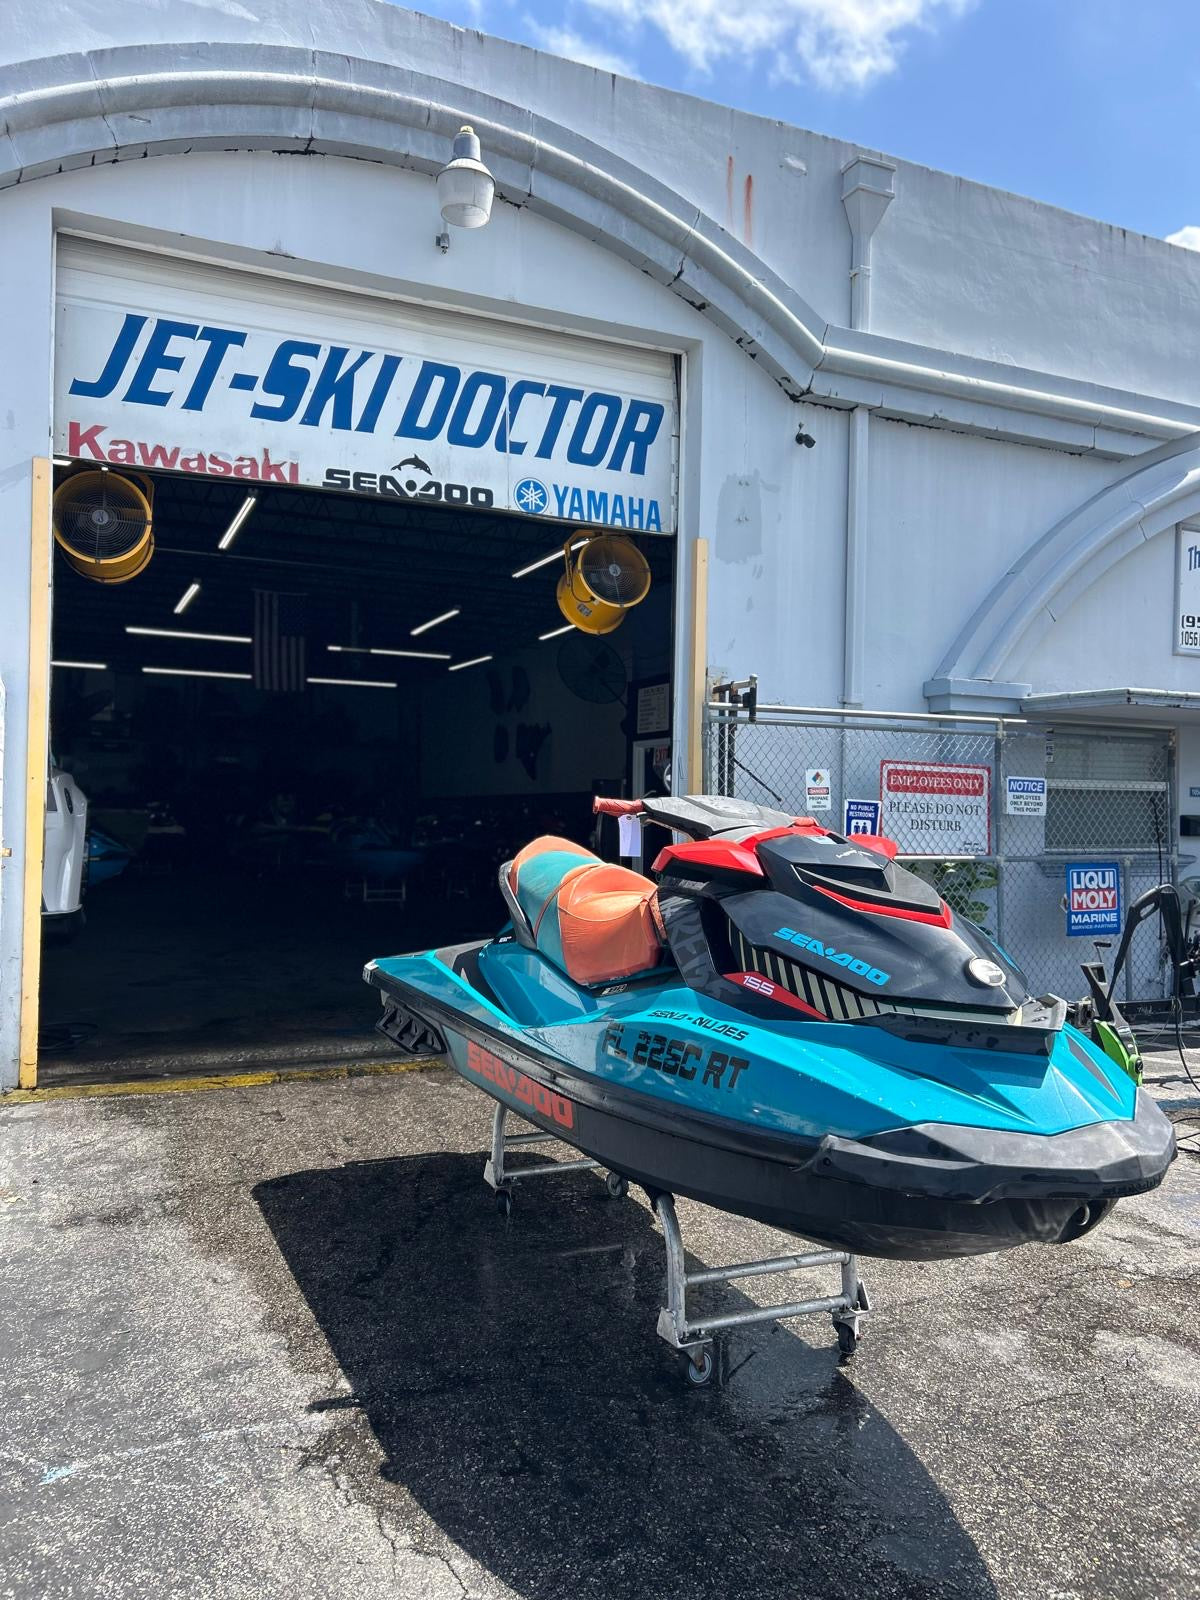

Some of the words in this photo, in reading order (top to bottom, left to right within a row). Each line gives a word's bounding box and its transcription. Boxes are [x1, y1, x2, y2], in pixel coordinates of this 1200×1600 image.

[69, 313, 402, 433] JET-SKI
[394, 360, 664, 475] DOCTOR
[68, 421, 299, 484] Kawasaki
[553, 484, 662, 532] YAMAHA
[890, 774, 952, 788] EMPLOYEES
[953, 778, 981, 789] ONLY
[1010, 781, 1044, 791] NOTICE
[889, 801, 934, 814] PLEASE
[936, 803, 954, 815] DO
[956, 804, 982, 816] NOT
[910, 819, 962, 832] DISTURB
[1072, 871, 1114, 889] LIQUI
[1073, 890, 1116, 909] MOLY
[1071, 912, 1118, 923] MARINE
[743, 975, 775, 996] 155
[702, 1051, 750, 1089] RT
